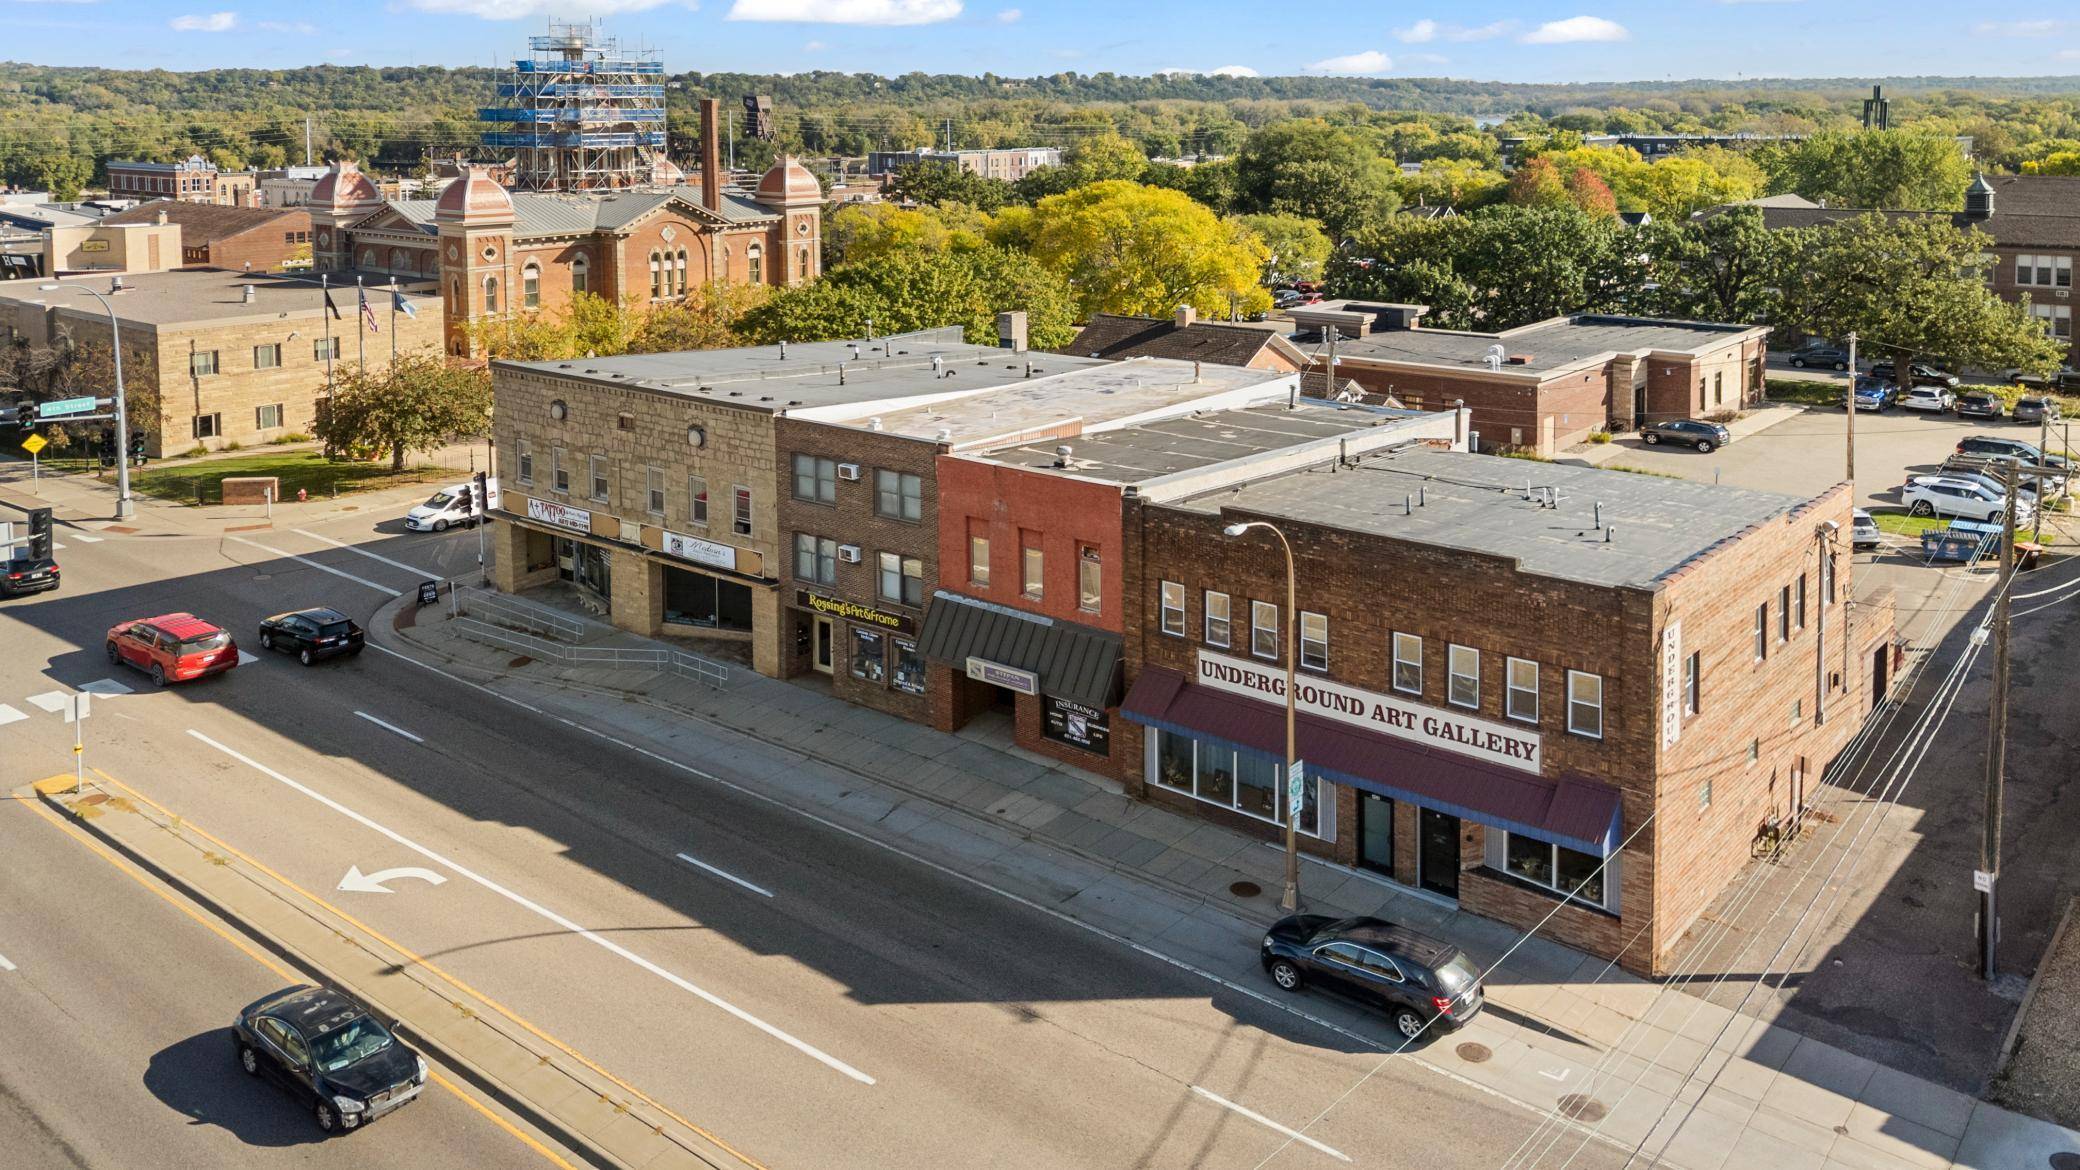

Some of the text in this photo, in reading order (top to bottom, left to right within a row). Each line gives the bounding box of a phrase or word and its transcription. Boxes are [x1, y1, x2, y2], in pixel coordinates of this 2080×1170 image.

[540, 502, 566, 523] TATTOO
[808, 593, 851, 617] Rossing's
[1055, 700, 1100, 718] INSURANCE
[1200, 658, 1538, 762] UNDERGROUND ART GALLERY
